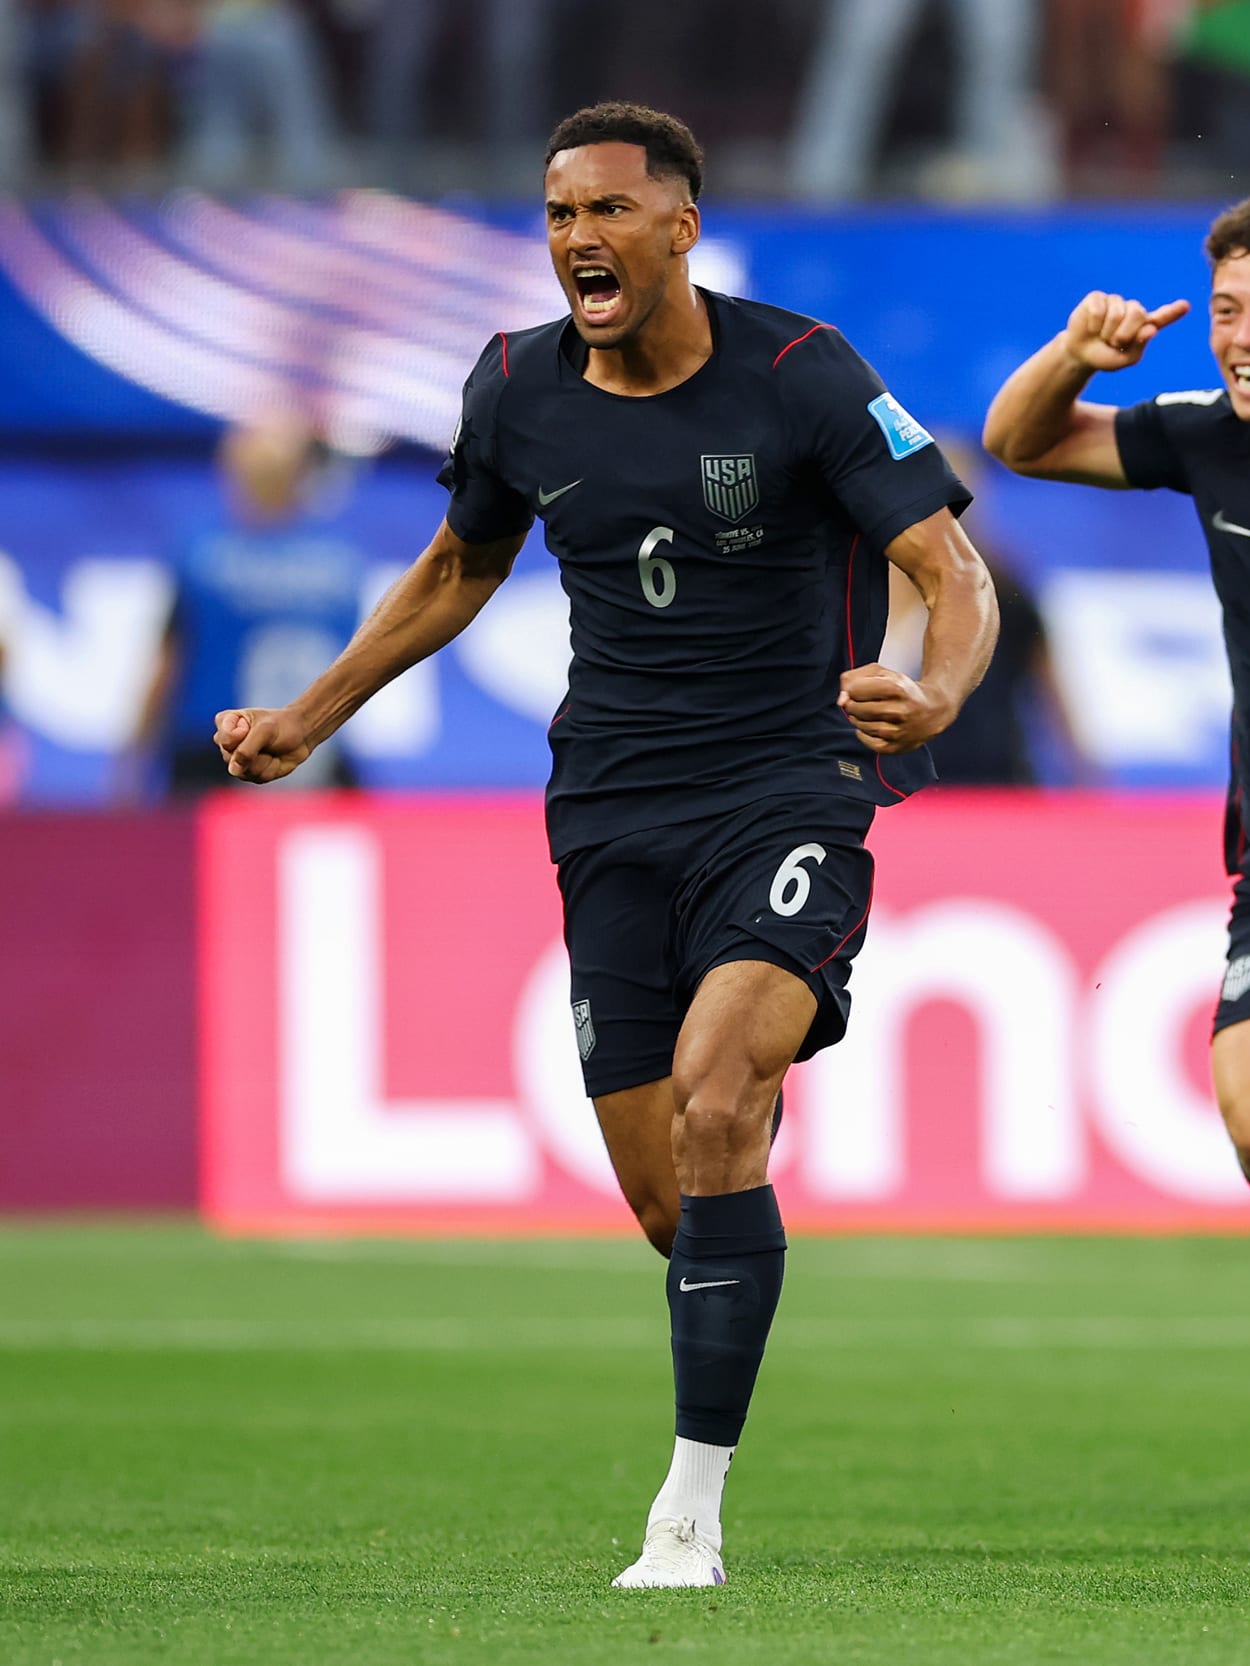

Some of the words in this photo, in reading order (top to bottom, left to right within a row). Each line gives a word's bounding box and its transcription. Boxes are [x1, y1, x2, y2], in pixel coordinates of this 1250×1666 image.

[705, 458, 751, 486] USA
[637, 525, 677, 609] 6
[768, 842, 827, 917] 6
